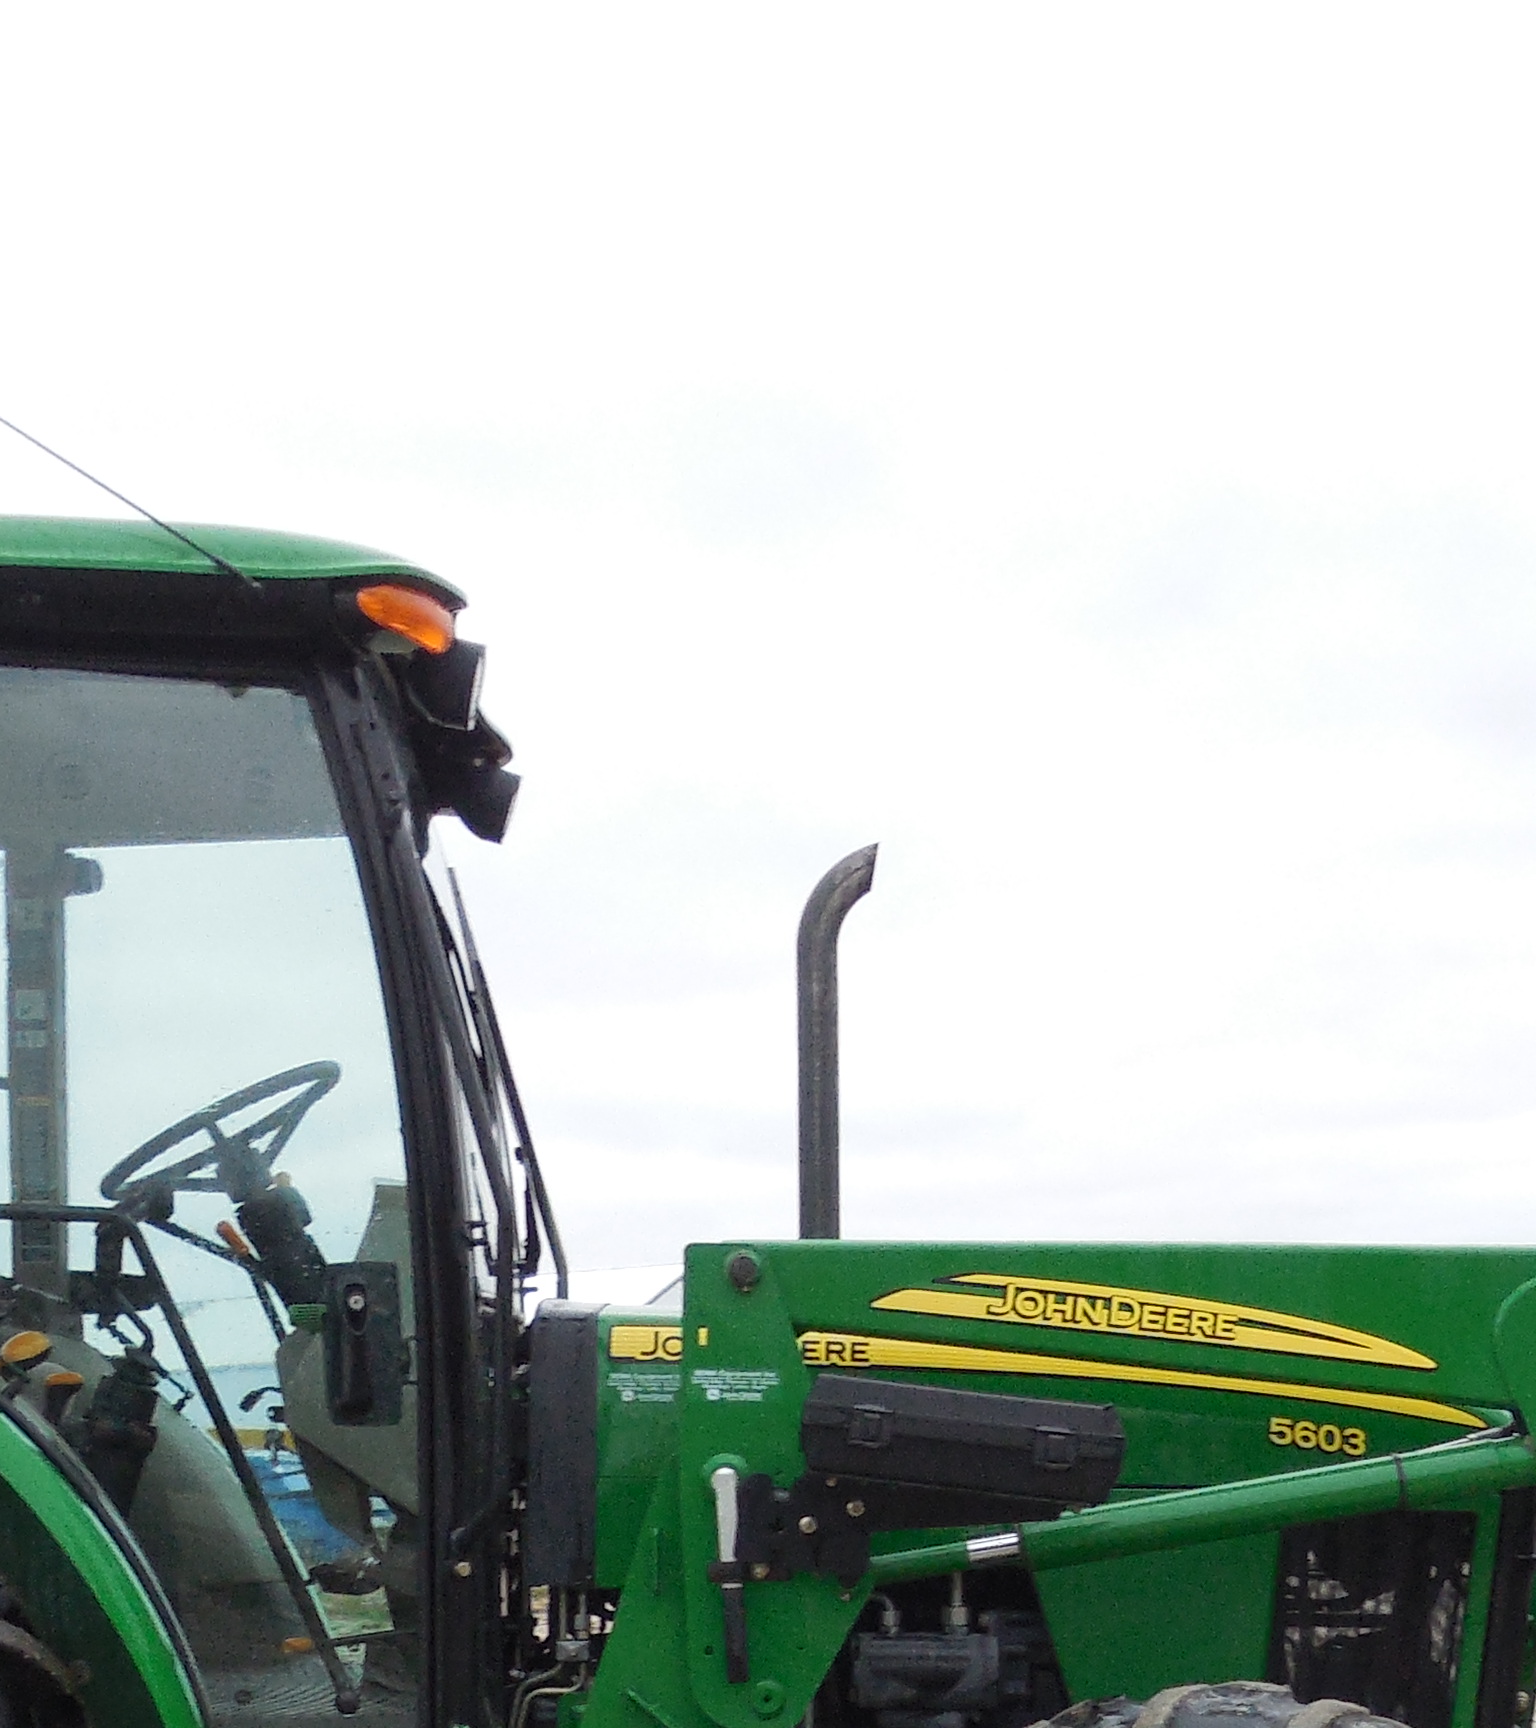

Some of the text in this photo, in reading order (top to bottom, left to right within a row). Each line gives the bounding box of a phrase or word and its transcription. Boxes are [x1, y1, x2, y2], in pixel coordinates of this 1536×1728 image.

[987, 1283, 1238, 1340] JOHN DEERE
[639, 1330, 870, 1363] JO ERE
[1268, 1416, 1367, 1456] 5603
